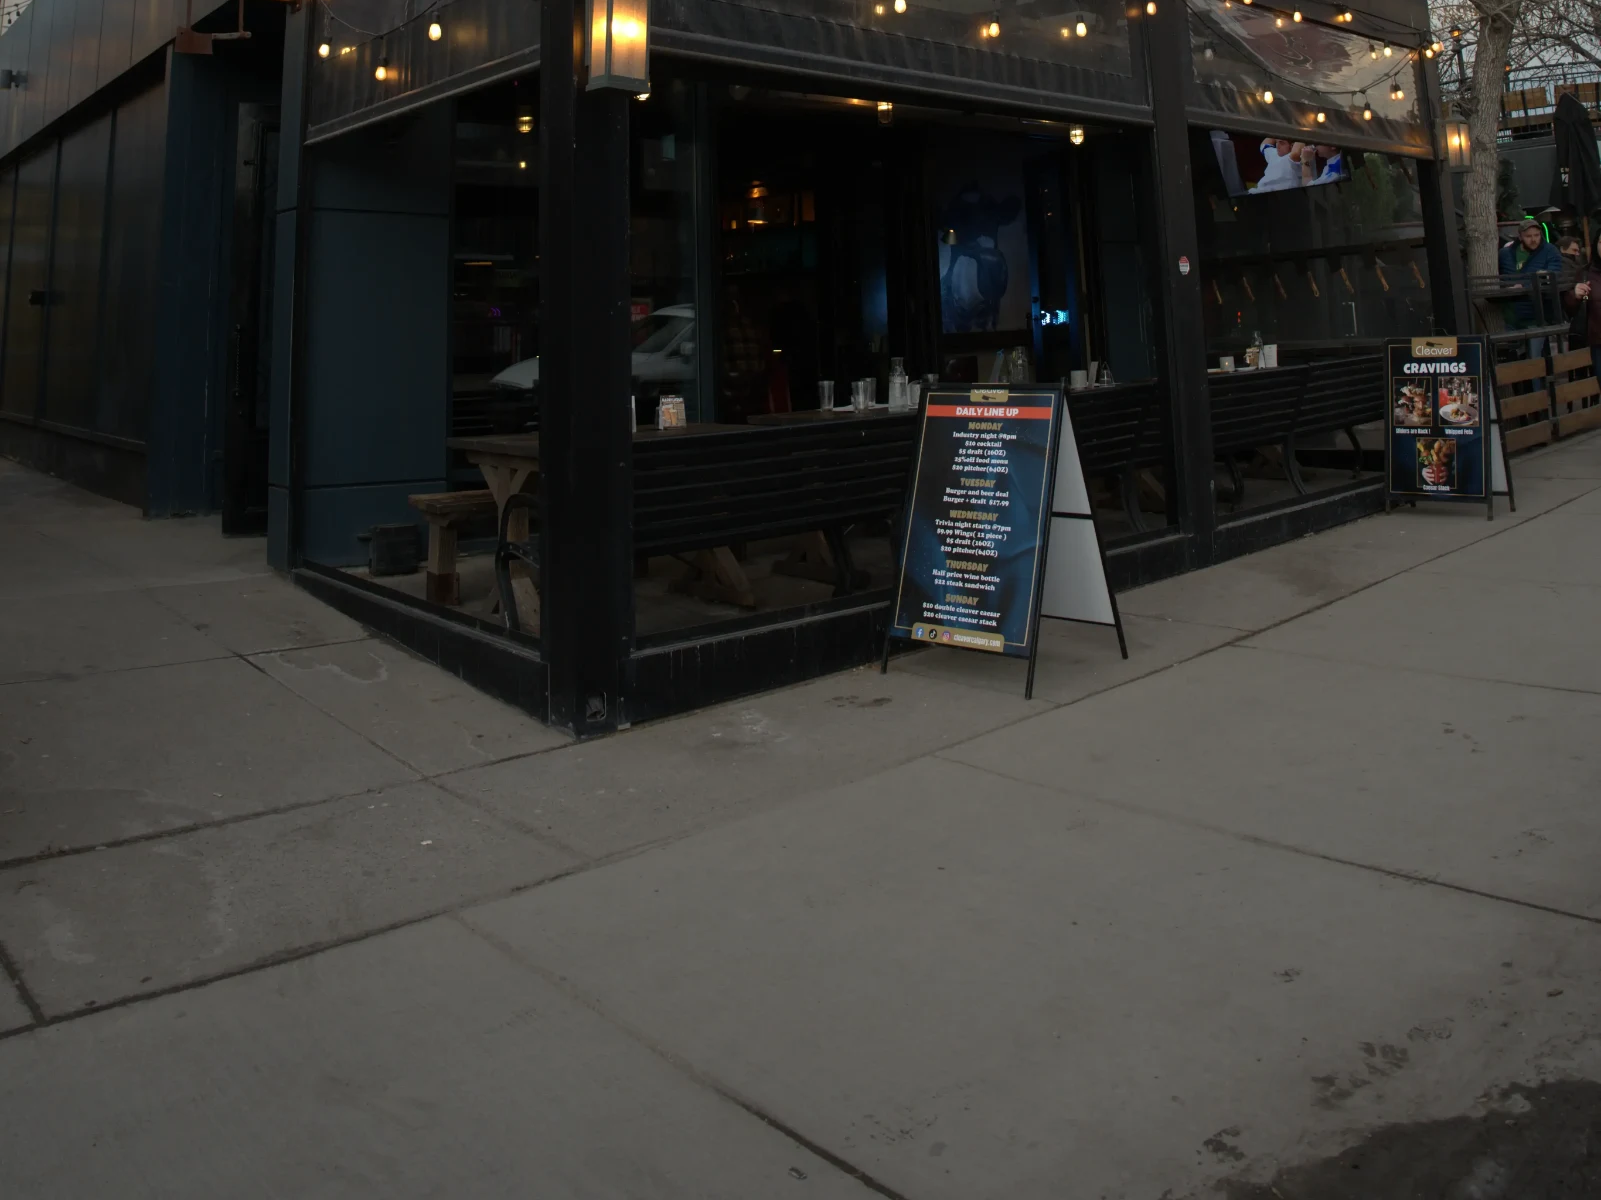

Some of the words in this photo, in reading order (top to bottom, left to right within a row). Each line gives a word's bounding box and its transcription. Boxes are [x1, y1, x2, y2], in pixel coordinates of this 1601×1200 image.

[1415, 345, 1454, 356] Cleaver
[1403, 361, 1467, 374] CRAVINGS
[956, 407, 983, 416] DAILY
[984, 407, 1005, 416] LINE
[1006, 408, 1019, 417] UP
[968, 422, 1003, 431] MONDAY
[952, 431, 979, 440] Industry
[980, 432, 997, 440] night
[960, 478, 996, 488] TUESDAY
[945, 487, 967, 496] Burger
[943, 495, 964, 504] Burger
[970, 497, 986, 505] draft
[989, 499, 1009, 507] $17.99
[949, 509, 999, 521] WEDNESDAY
[935, 519, 954, 527] Trivia
[954, 520, 972, 529] night
[972, 522, 991, 530] starts
[992, 524, 1011, 532] @7pm
[985, 532, 1002, 541] piece
[945, 560, 989, 572] THURSDAY
[932, 569, 946, 577] Half
[946, 571, 962, 579] price
[980, 575, 1000, 583] bottle
[964, 582, 995, 591] sandwich
[945, 593, 979, 606] SUNDAY
[934, 603, 955, 612] double
[956, 606, 979, 615] cleaver
[980, 610, 1001, 618] caesar
[935, 612, 957, 621] cleaver
[958, 616, 978, 624] caesar
[979, 619, 997, 627] stack
